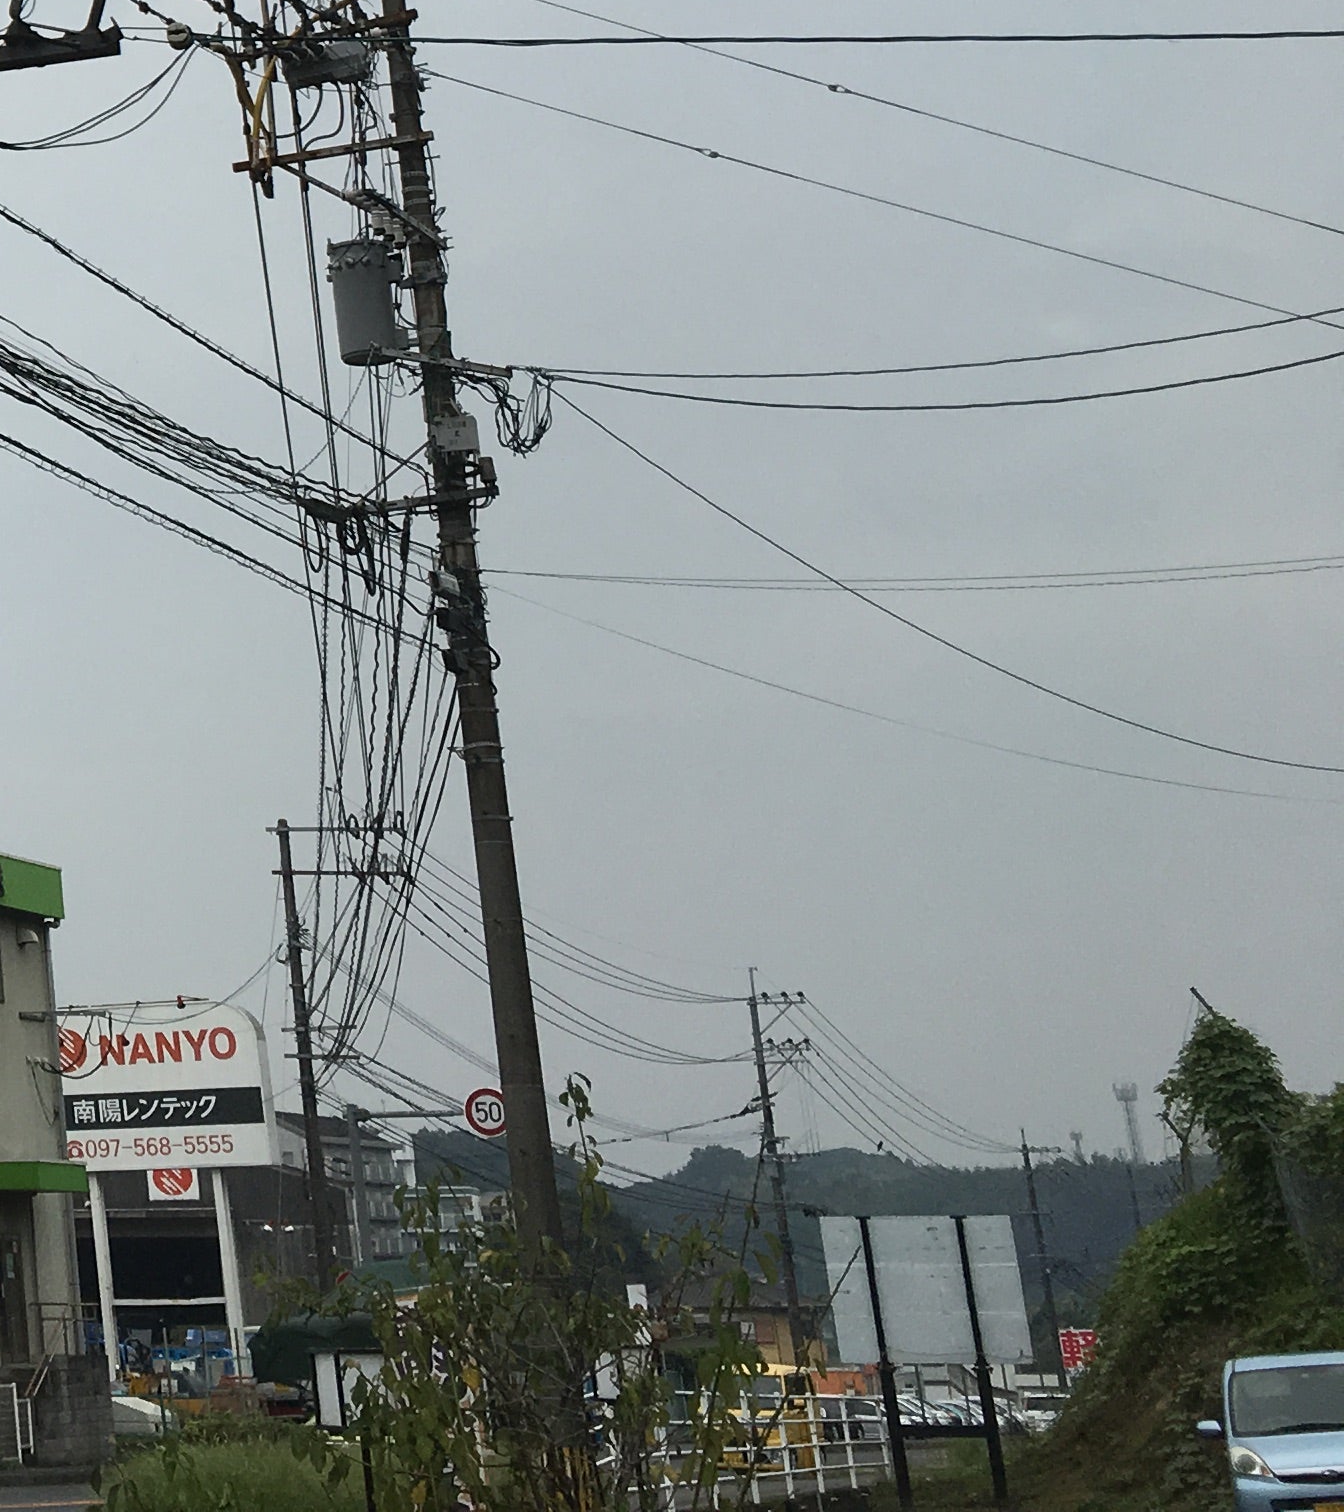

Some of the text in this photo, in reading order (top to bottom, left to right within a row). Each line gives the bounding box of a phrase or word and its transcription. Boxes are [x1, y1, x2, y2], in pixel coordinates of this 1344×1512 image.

[99, 1026, 237, 1066] NANYO
[72, 1095, 217, 1124] 南陽レンテック
[475, 1101, 502, 1123] 50
[85, 1134, 234, 1159] 097-568-5555
